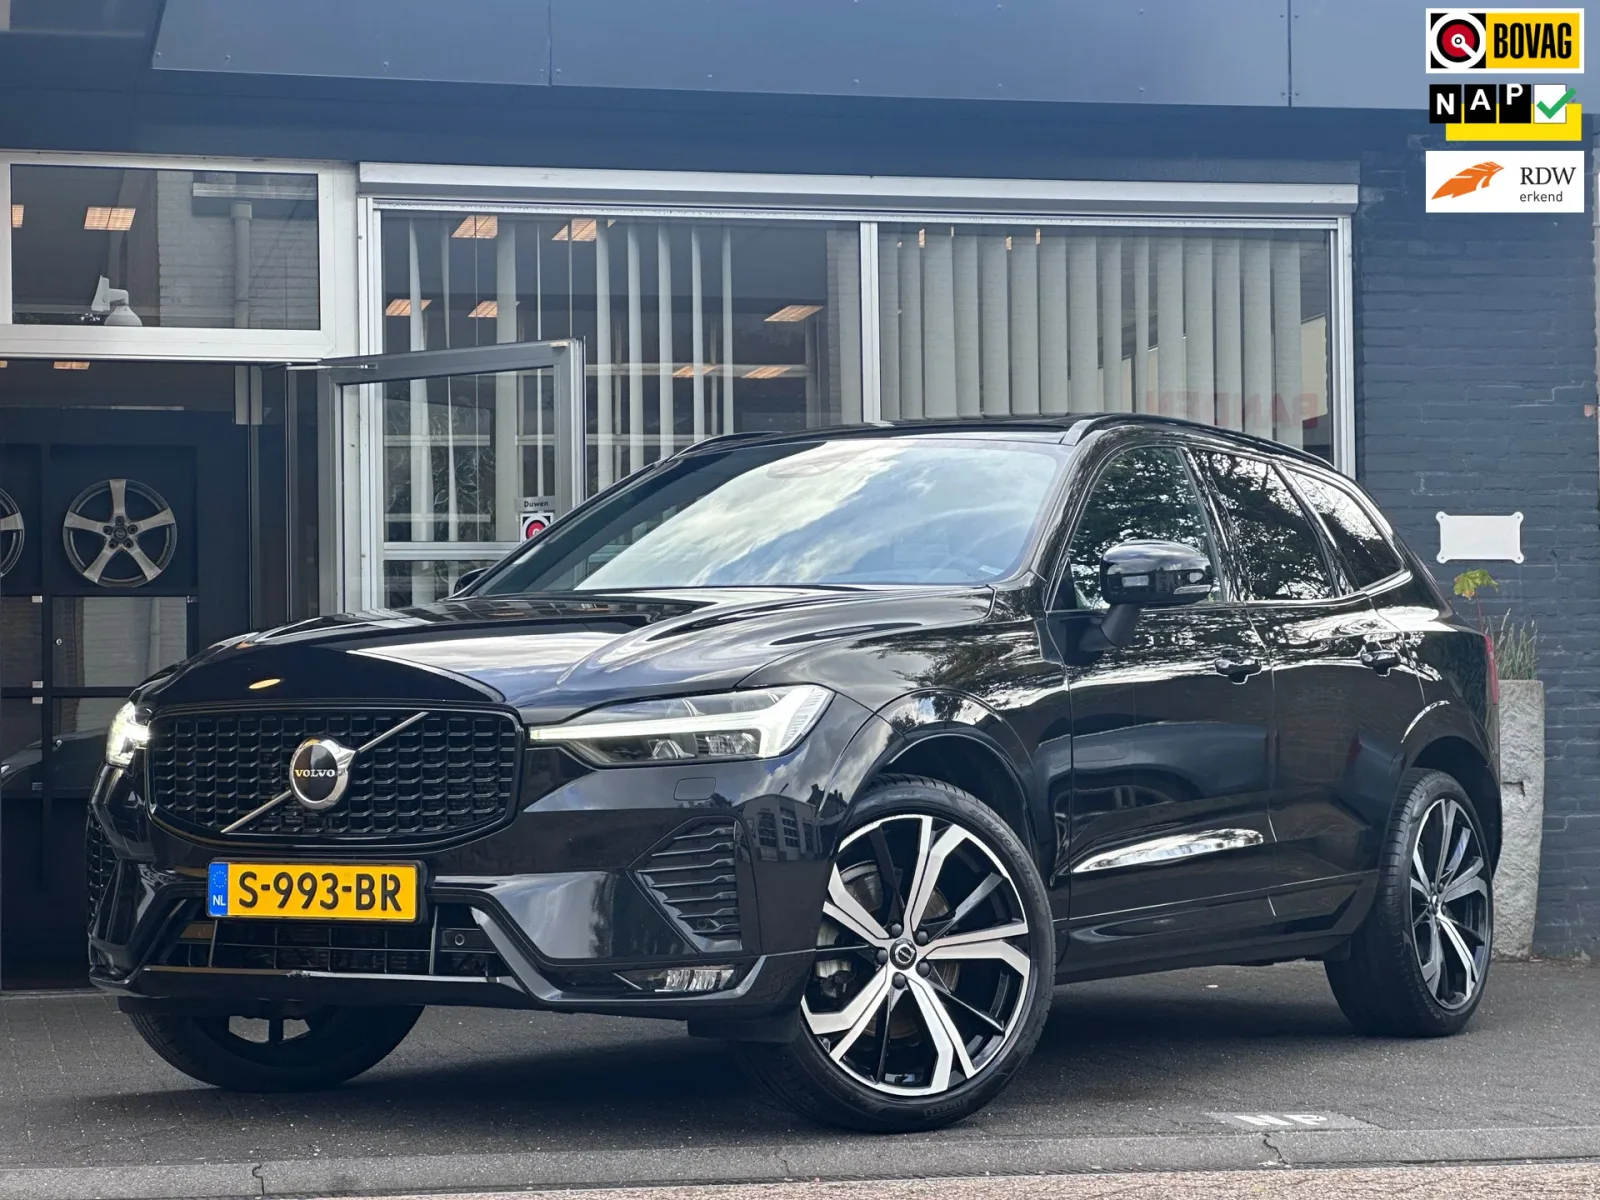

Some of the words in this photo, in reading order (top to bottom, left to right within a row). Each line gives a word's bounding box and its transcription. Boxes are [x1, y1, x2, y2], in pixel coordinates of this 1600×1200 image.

[295, 769, 336, 778] VOLVO
[212, 894, 226, 906] NL
[238, 870, 402, 912] S-993-BR
